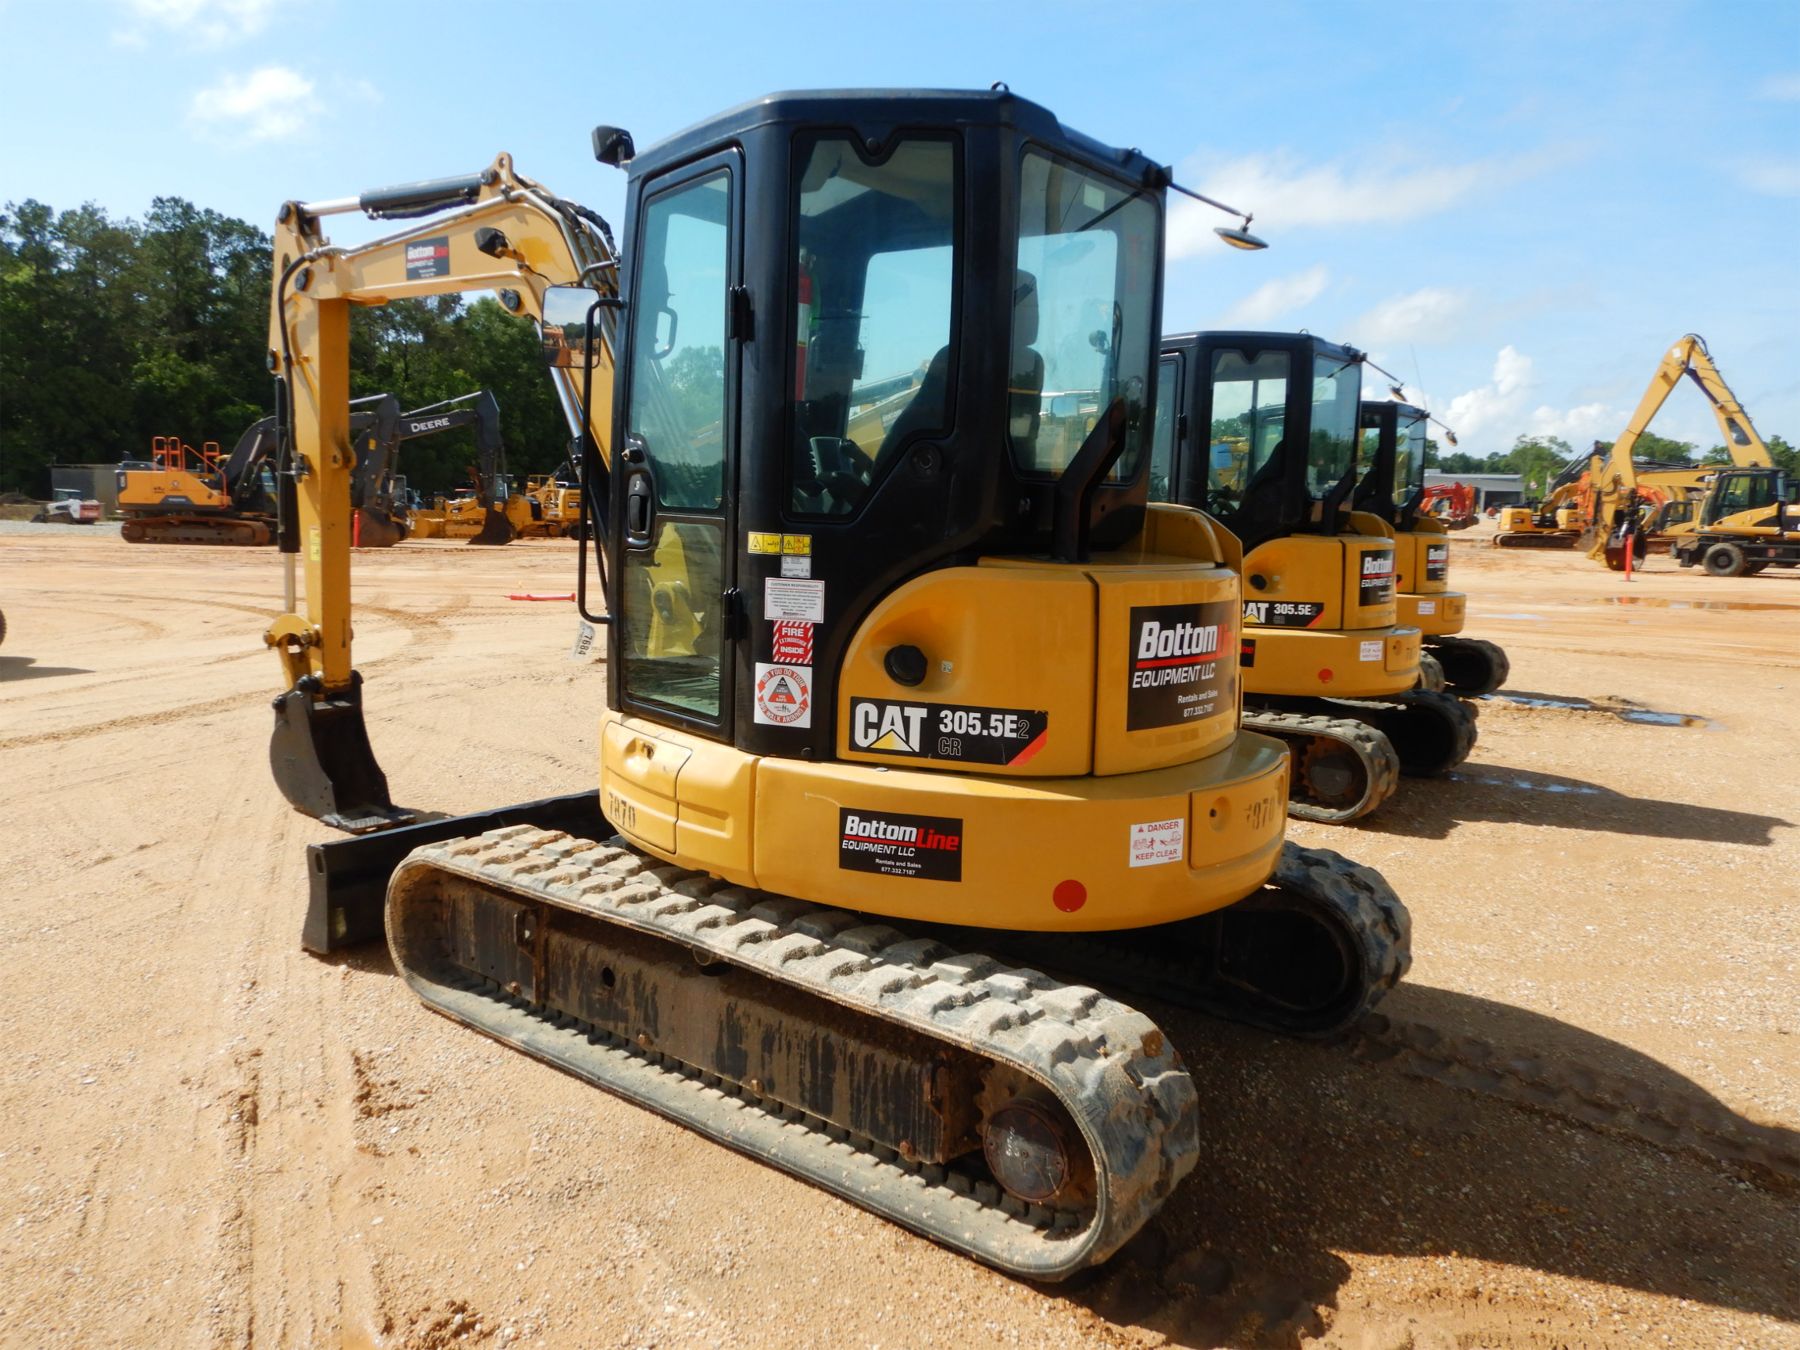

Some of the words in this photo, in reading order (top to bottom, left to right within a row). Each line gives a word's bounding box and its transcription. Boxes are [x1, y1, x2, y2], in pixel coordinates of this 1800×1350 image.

[410, 417, 449, 432] DEERE
[1242, 602, 1269, 624] AT
[782, 627, 804, 637] FIRE
[780, 646, 805, 655] INSIDE
[1132, 665, 1201, 688] EQUIPMENT
[1201, 663, 1216, 680] LLC
[1177, 694, 1198, 704] Rentals
[854, 702, 928, 752] CAT
[937, 737, 962, 756] CR
[1147, 821, 1179, 832] DANGER
[842, 839, 897, 855] EQUIPMENT
[897, 846, 916, 857] LLC
[1135, 852, 1154, 860] KEEP
[1155, 849, 1178, 858] CLEAR
[875, 858, 895, 867] Rentals
